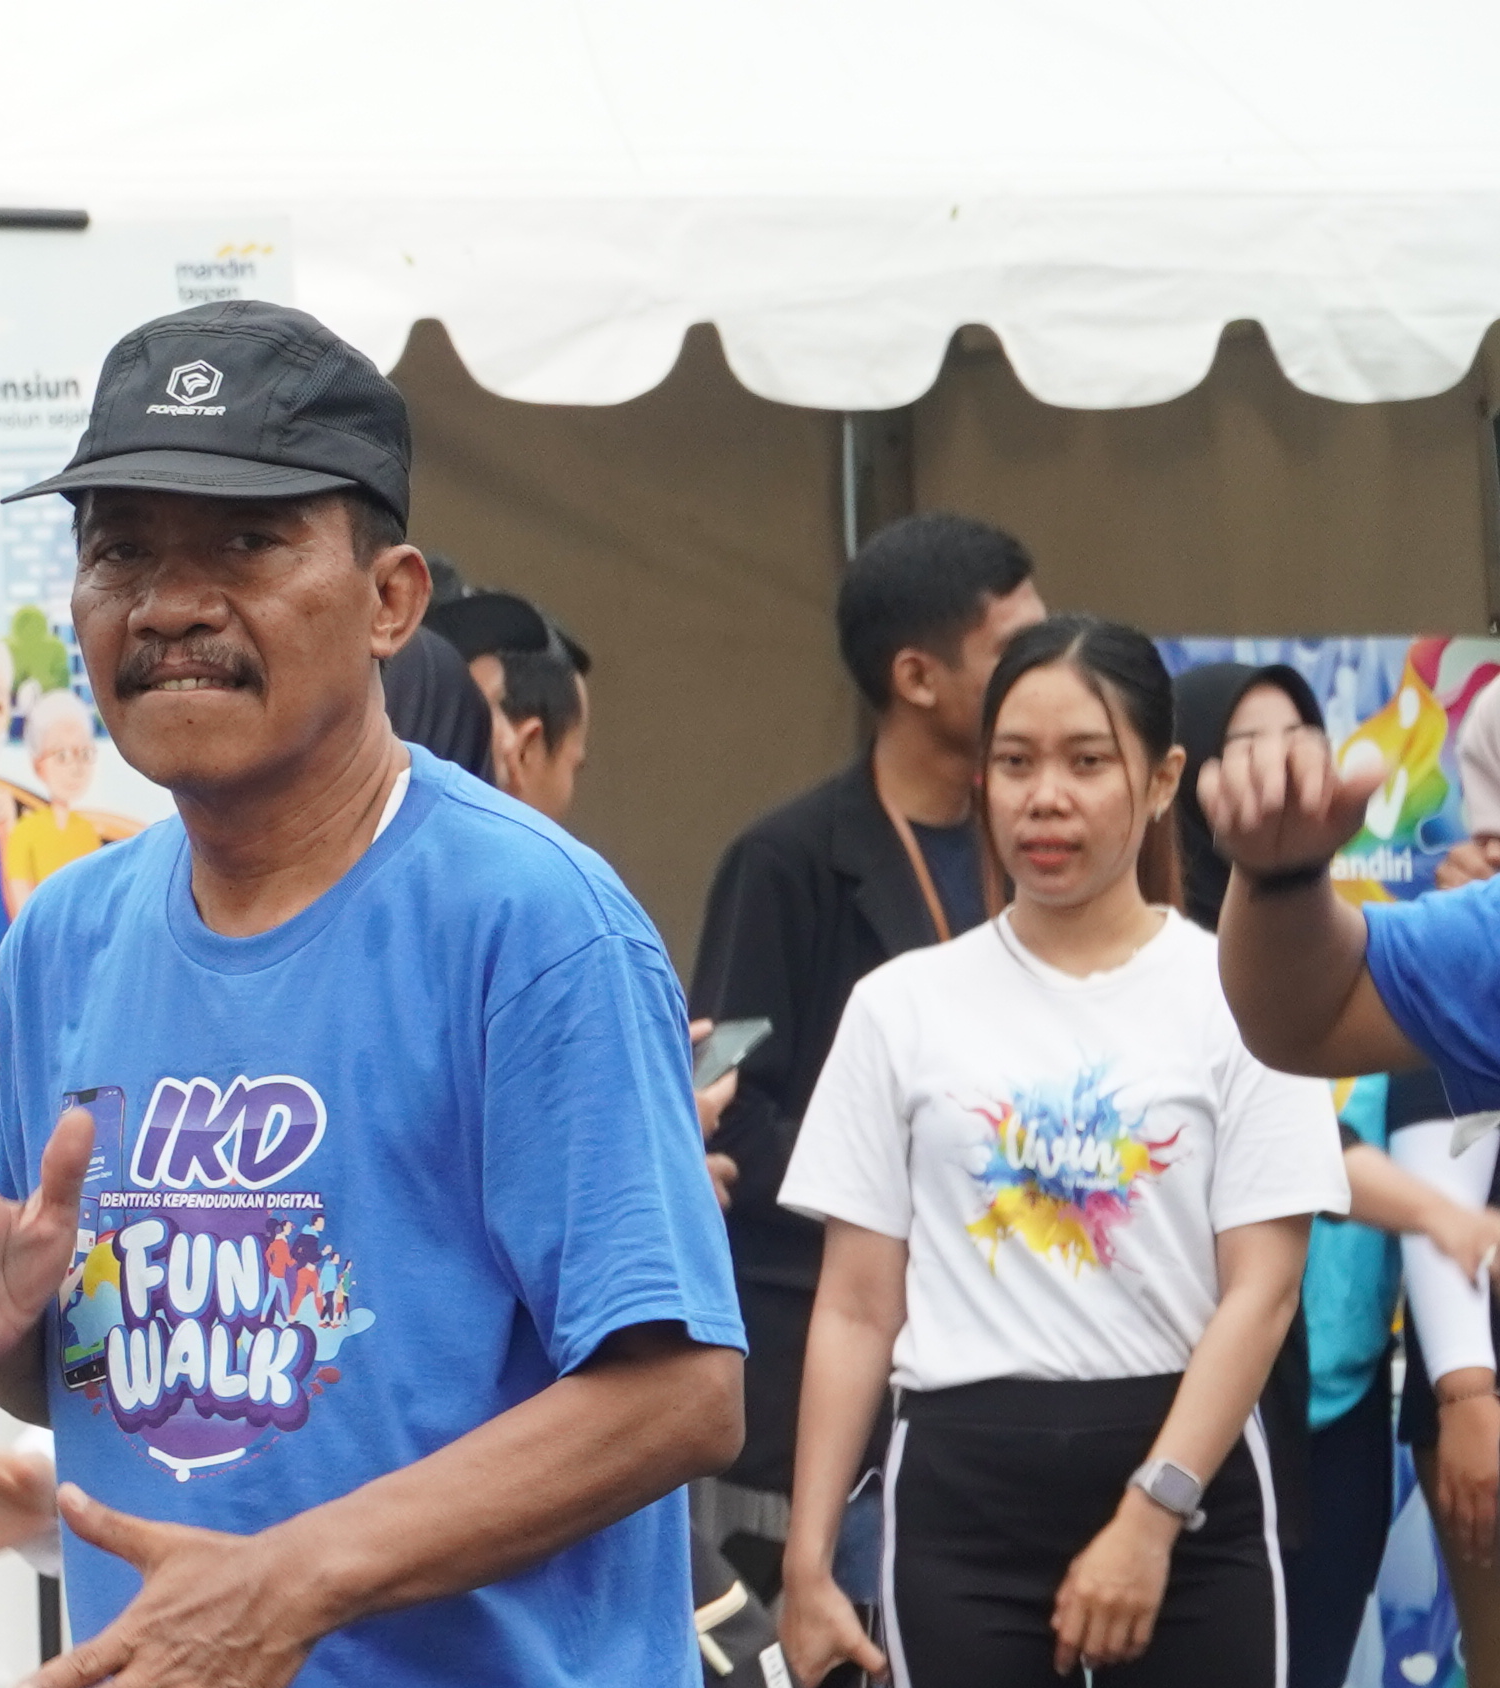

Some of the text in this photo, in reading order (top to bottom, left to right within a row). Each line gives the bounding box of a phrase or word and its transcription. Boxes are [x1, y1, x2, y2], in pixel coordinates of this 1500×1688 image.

[146, 404, 227, 417] FORESTER
[1330, 846, 1413, 882] andiri
[129, 1074, 327, 1190] IKD
[100, 1192, 324, 1210] IDENTITAS KEPENDUDUKAN DIGITAL
[118, 1216, 266, 1321] FUN
[106, 1319, 300, 1411] WALK
